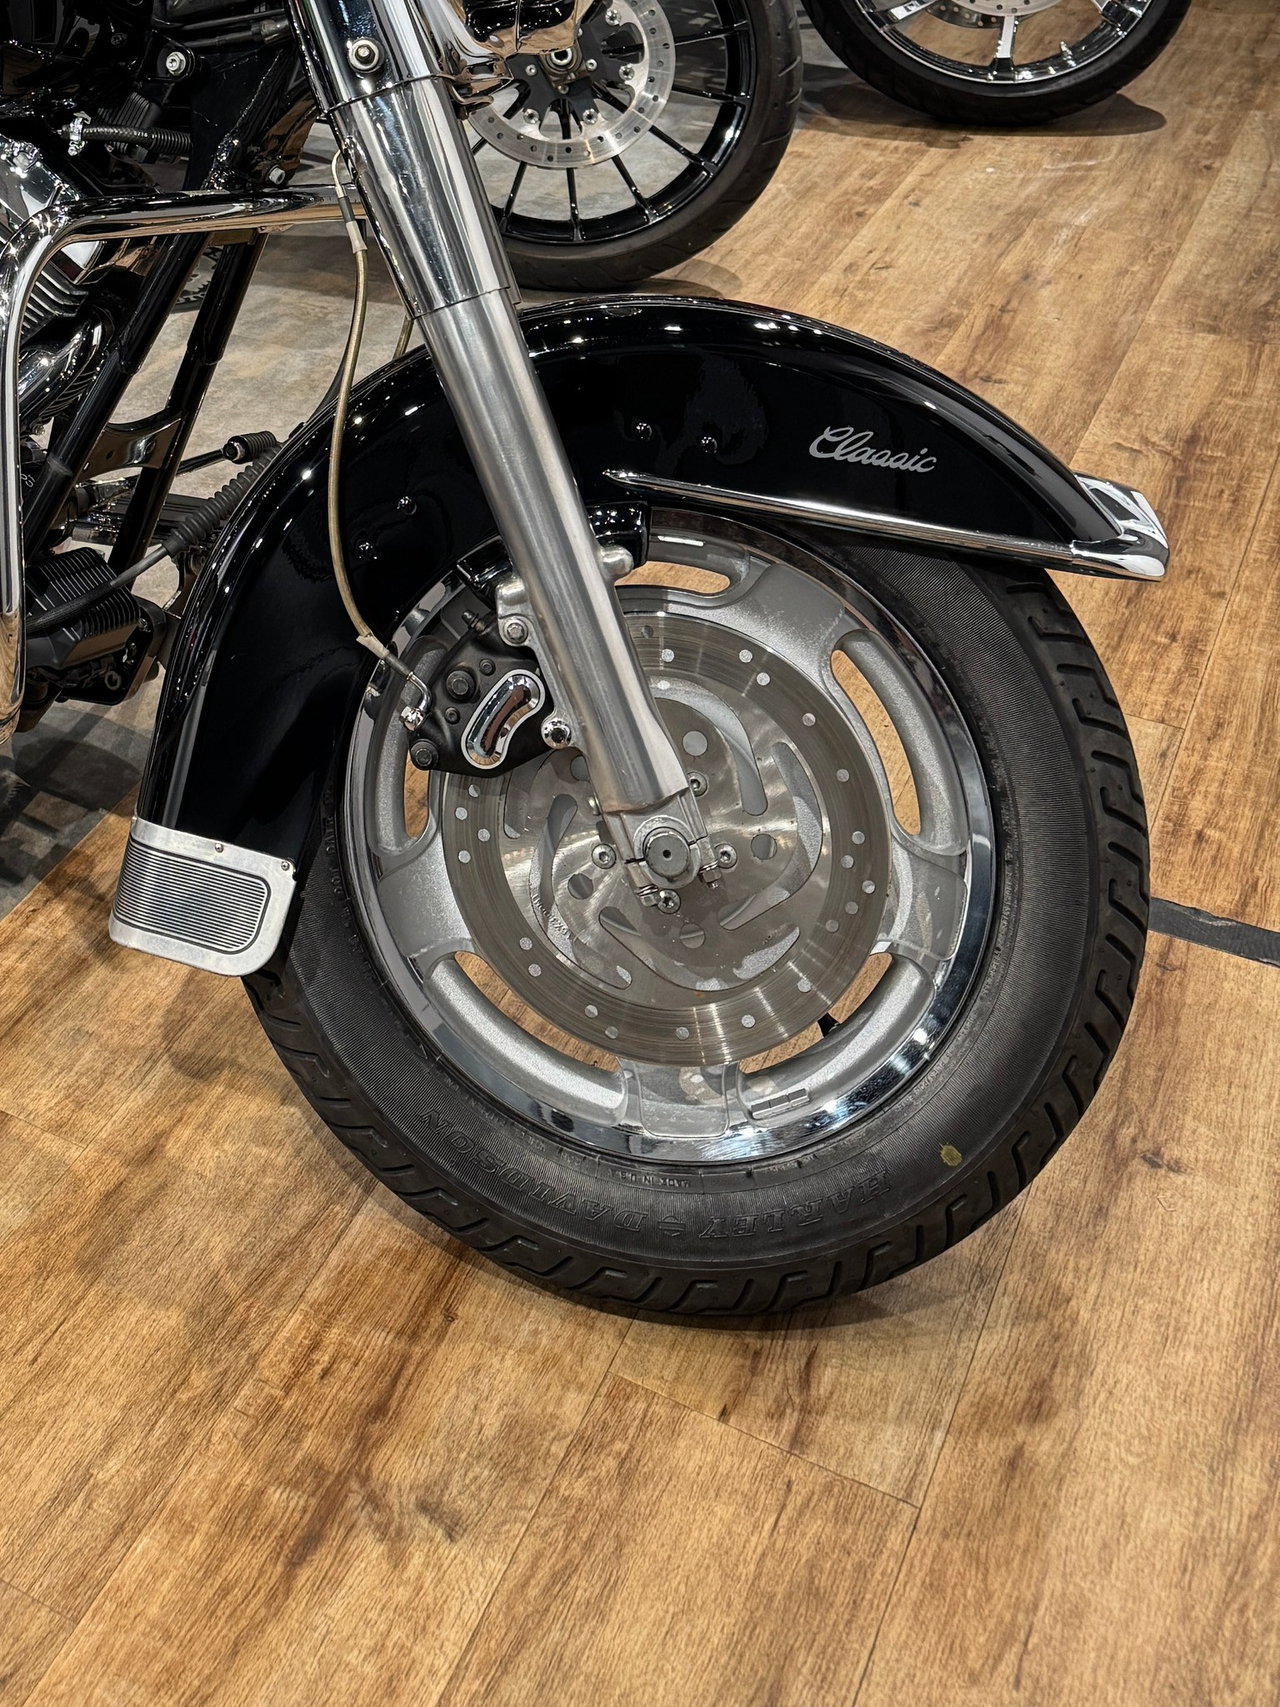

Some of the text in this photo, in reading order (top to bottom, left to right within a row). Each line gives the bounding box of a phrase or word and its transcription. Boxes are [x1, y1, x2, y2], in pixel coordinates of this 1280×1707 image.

[809, 425, 937, 473] Classic
[421, 1109, 891, 1238] HARLEY DAVIDSON
